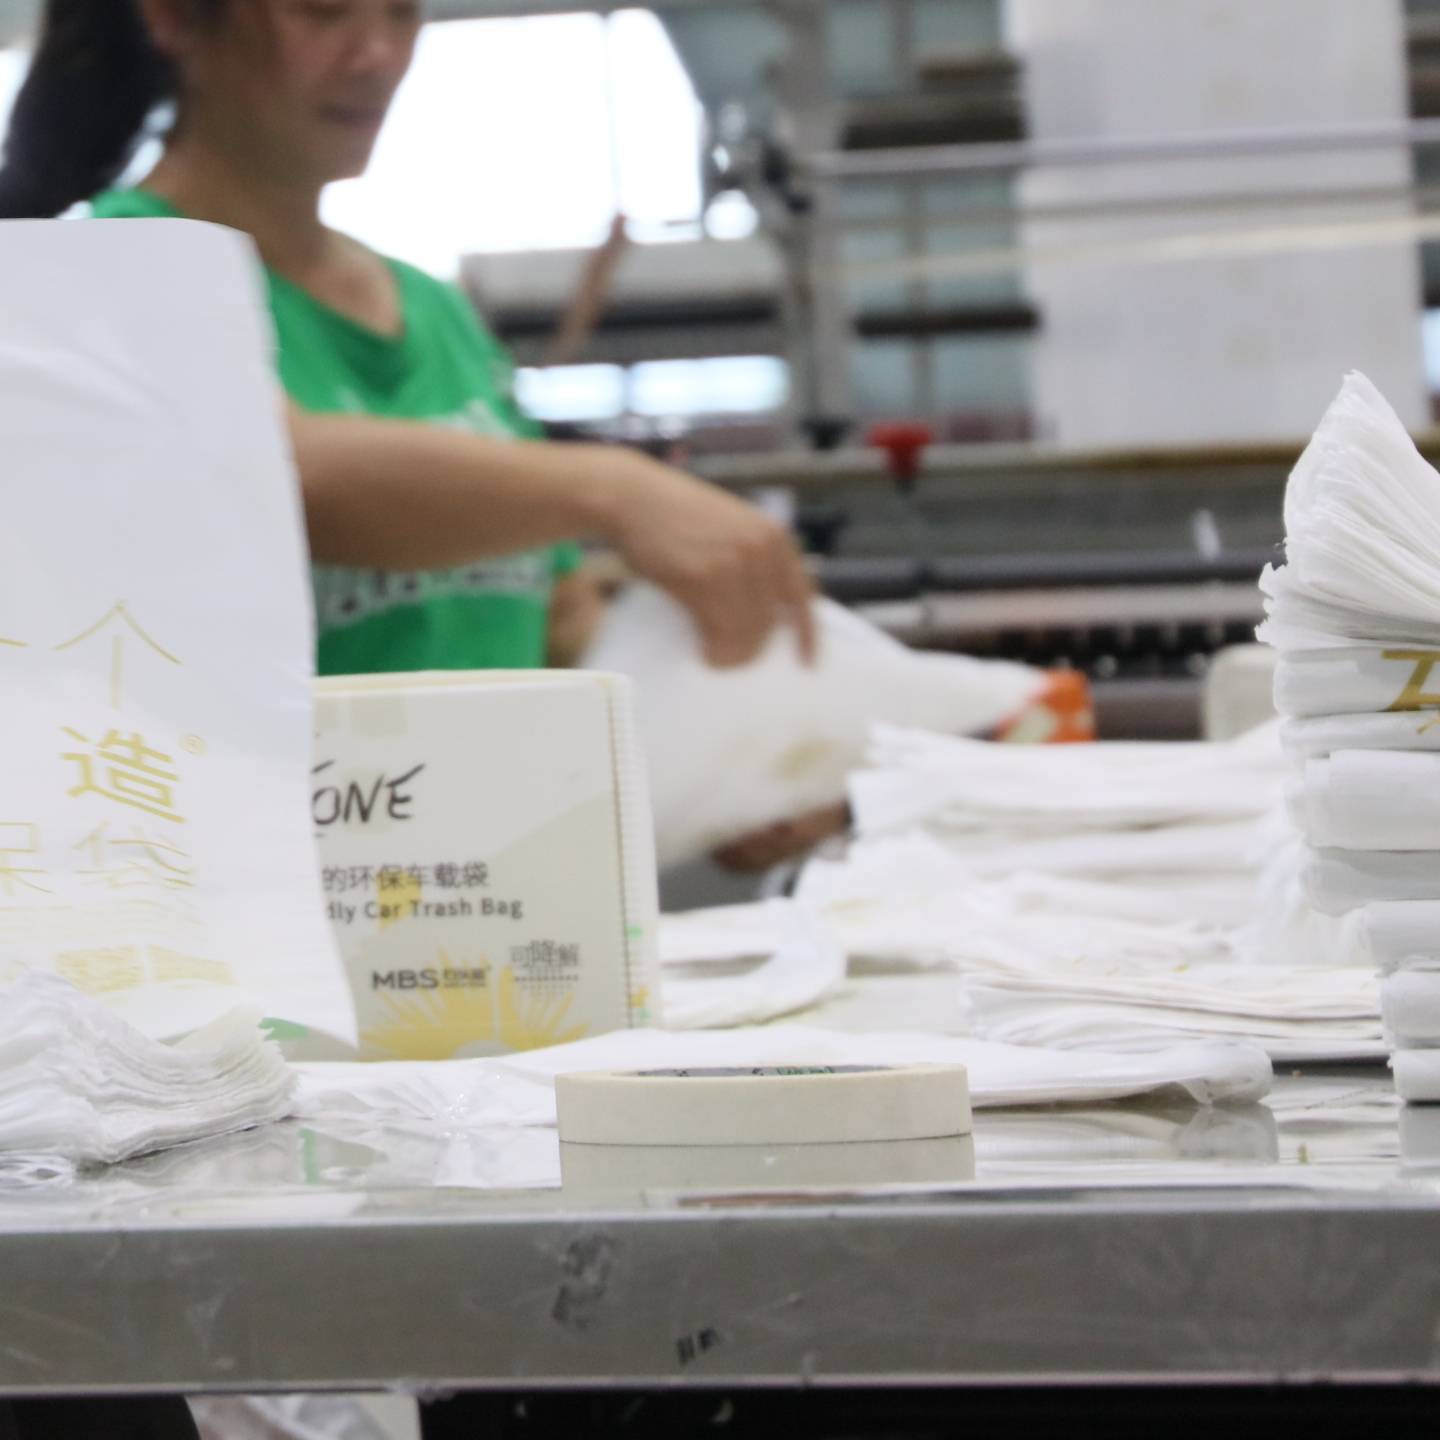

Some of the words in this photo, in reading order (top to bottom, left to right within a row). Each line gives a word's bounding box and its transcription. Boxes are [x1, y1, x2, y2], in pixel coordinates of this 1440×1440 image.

[312, 760, 426, 827] ONE
[322, 862, 489, 892] 的环保车载袋
[364, 900, 402, 920] Car
[410, 897, 473, 919] Trash
[481, 897, 524, 920] Bag
[371, 969, 439, 991] MBS
